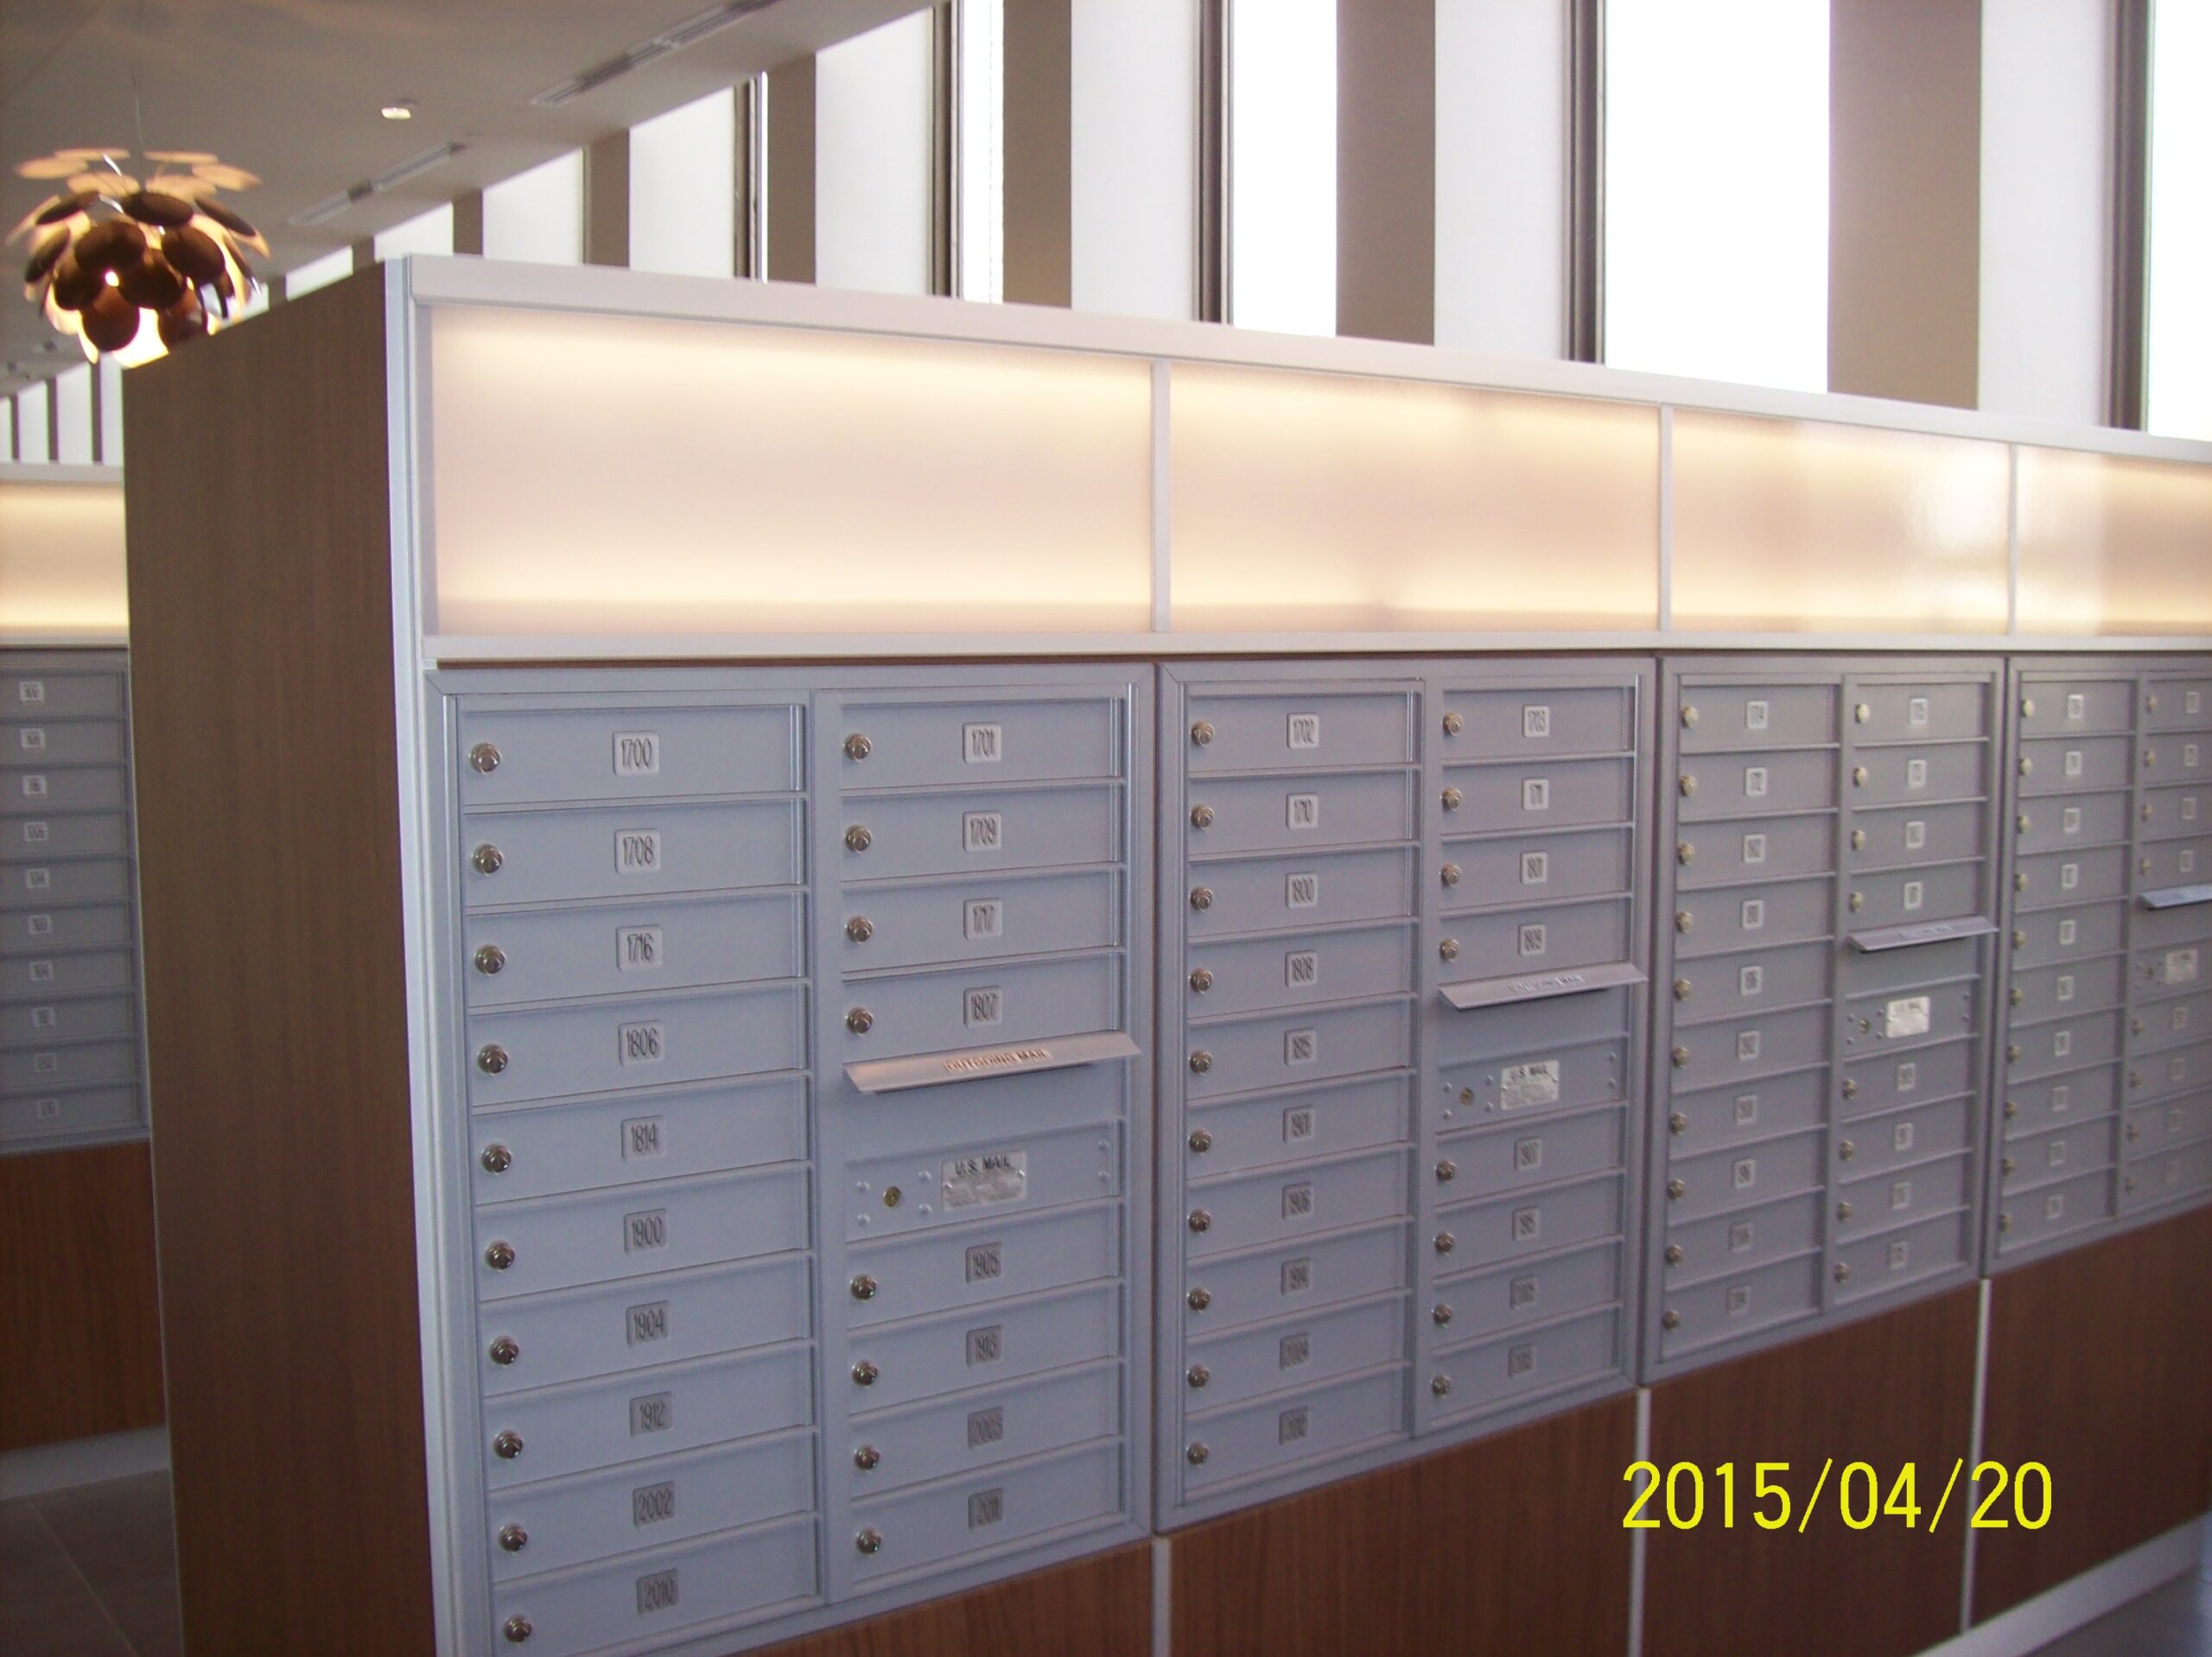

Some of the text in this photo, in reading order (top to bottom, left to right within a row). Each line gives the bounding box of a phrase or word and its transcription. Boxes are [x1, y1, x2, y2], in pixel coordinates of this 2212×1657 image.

[621, 738, 652, 768] 1700
[971, 728, 995, 758] 1701
[970, 816, 996, 846] 1709
[623, 835, 654, 866] 1708
[626, 932, 654, 962] 1716
[626, 1027, 658, 1057] 1806
[1016, 1048, 1048, 1062] MAIL
[631, 1123, 658, 1153] 1814
[982, 1154, 1013, 1171] MAIL
[632, 1216, 662, 1247] 1900
[633, 1309, 664, 1339] 1904
[639, 1400, 665, 1429] 1912
[639, 1489, 671, 1521] 2002
[644, 1578, 674, 1609] 2010
